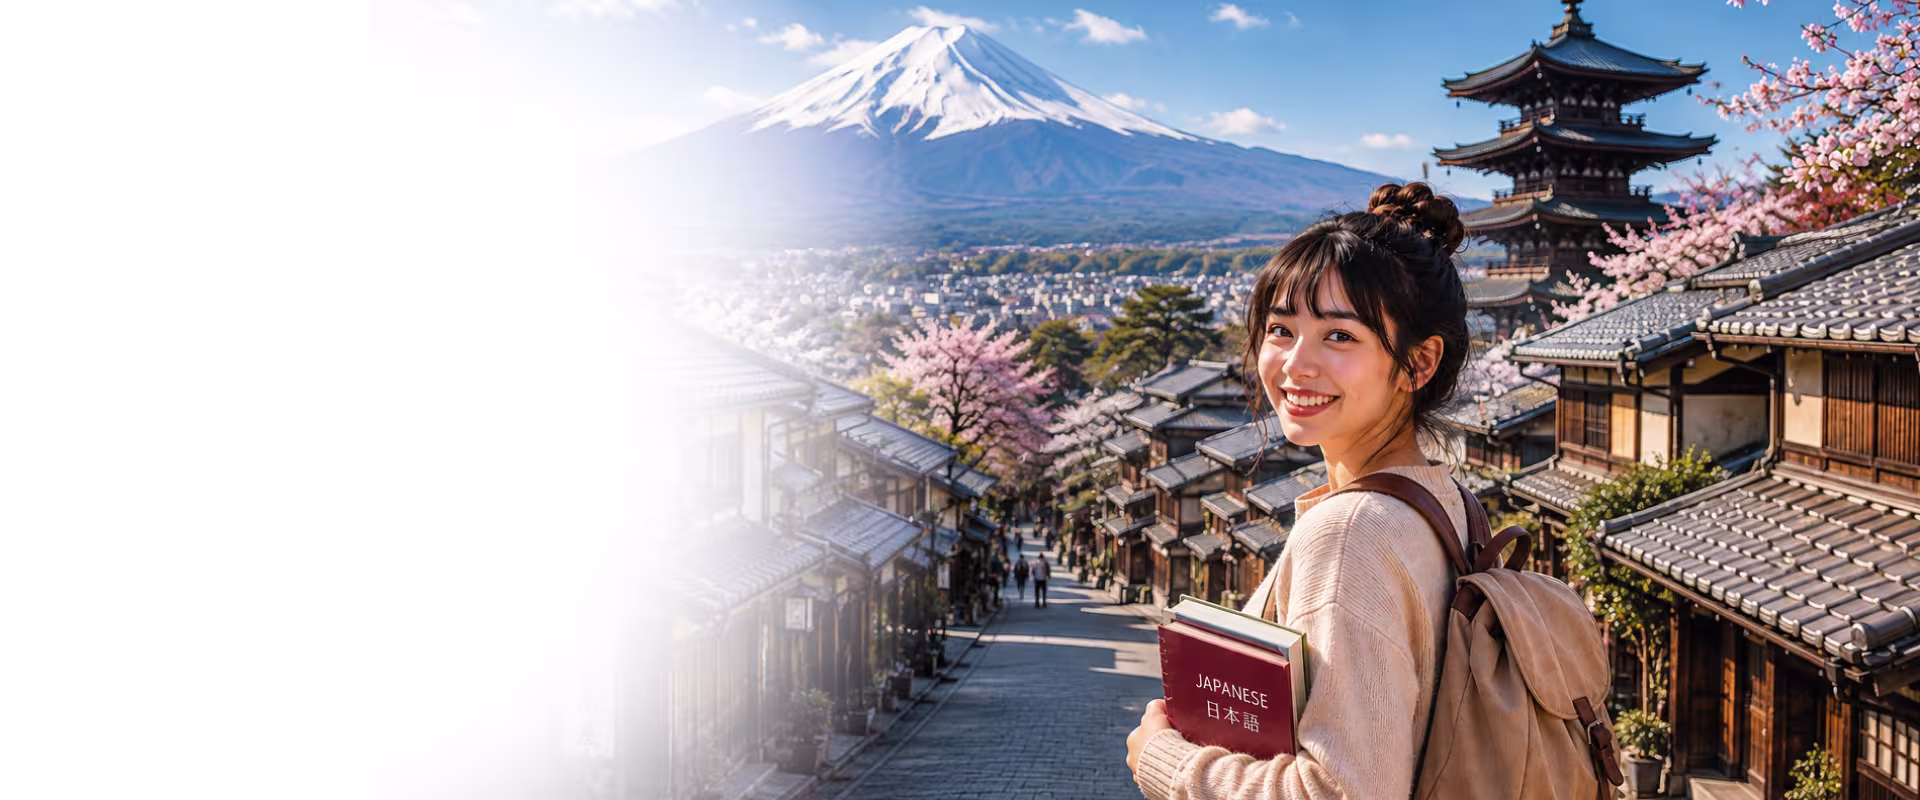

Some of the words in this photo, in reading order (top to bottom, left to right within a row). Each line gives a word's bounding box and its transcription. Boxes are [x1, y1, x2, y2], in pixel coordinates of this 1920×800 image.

[1196, 673, 1268, 709] JAPANESE
[1207, 700, 1259, 733] 日本語
